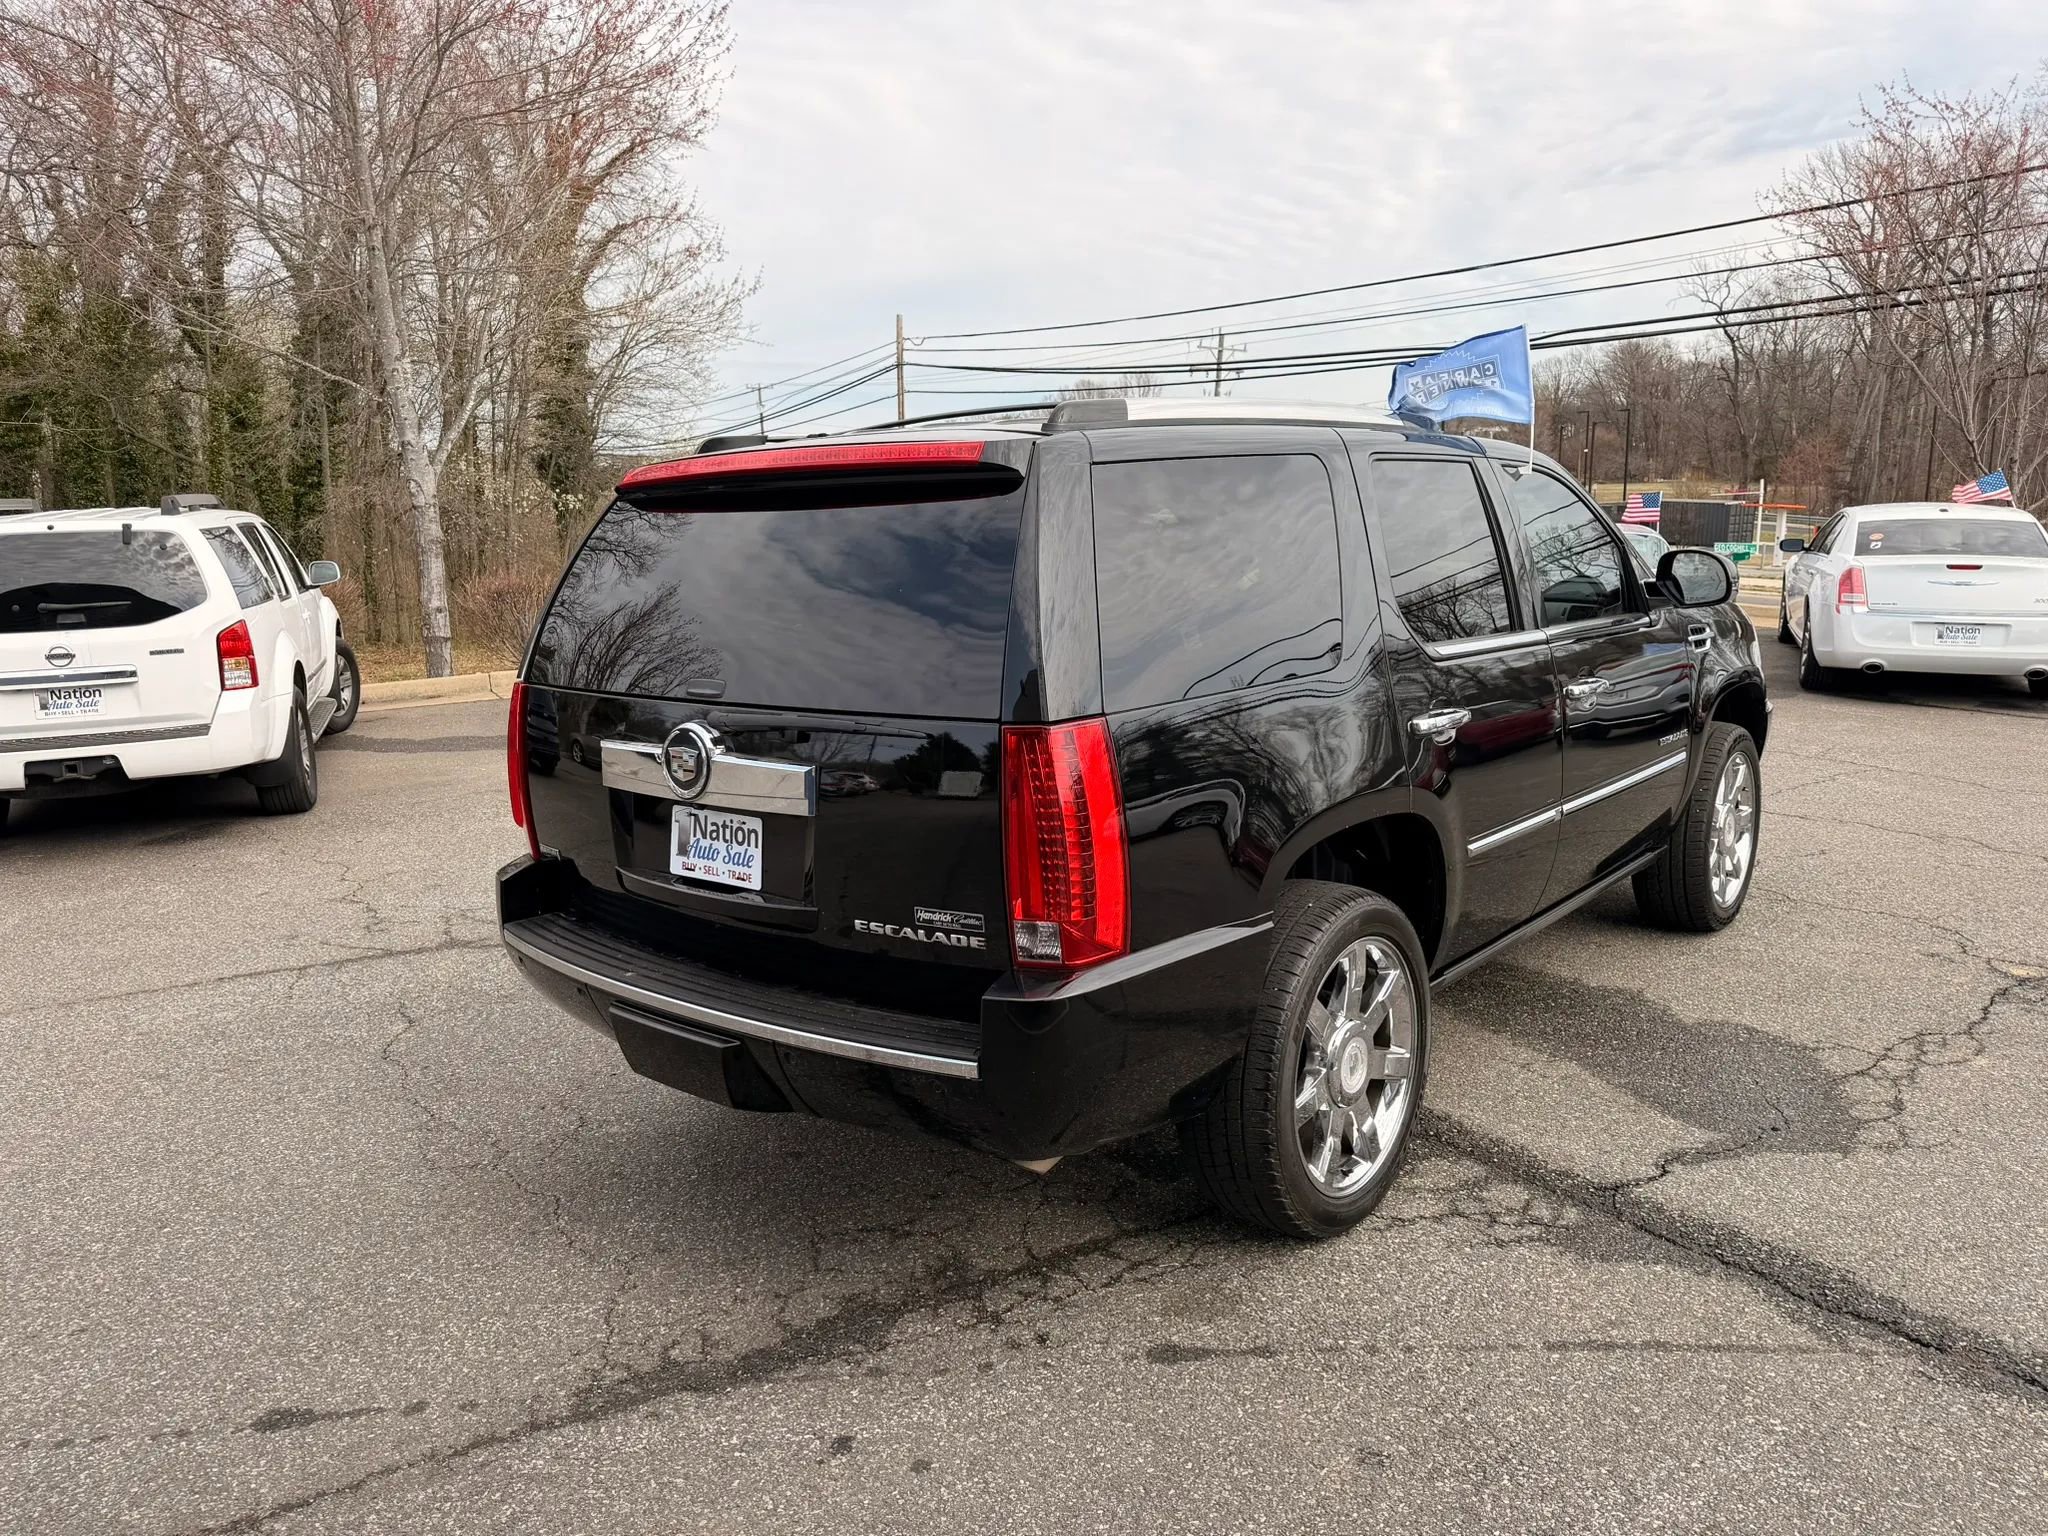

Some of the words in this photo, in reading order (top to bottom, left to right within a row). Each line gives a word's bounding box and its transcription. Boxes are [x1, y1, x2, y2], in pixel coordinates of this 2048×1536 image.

[1945, 625, 1981, 635] Nation
[49, 687, 102, 701] Nation
[47, 699, 74, 711] Auto
[75, 698, 100, 709] Sale
[693, 814, 759, 849] Nation
[687, 837, 721, 861] Auto
[722, 843, 755, 869] Sale
[681, 861, 698, 873] BUY
[703, 864, 721, 877] SELL
[727, 869, 753, 884] TRADE
[916, 909, 952, 923] Hendrick
[854, 919, 987, 950] ESCALADE
